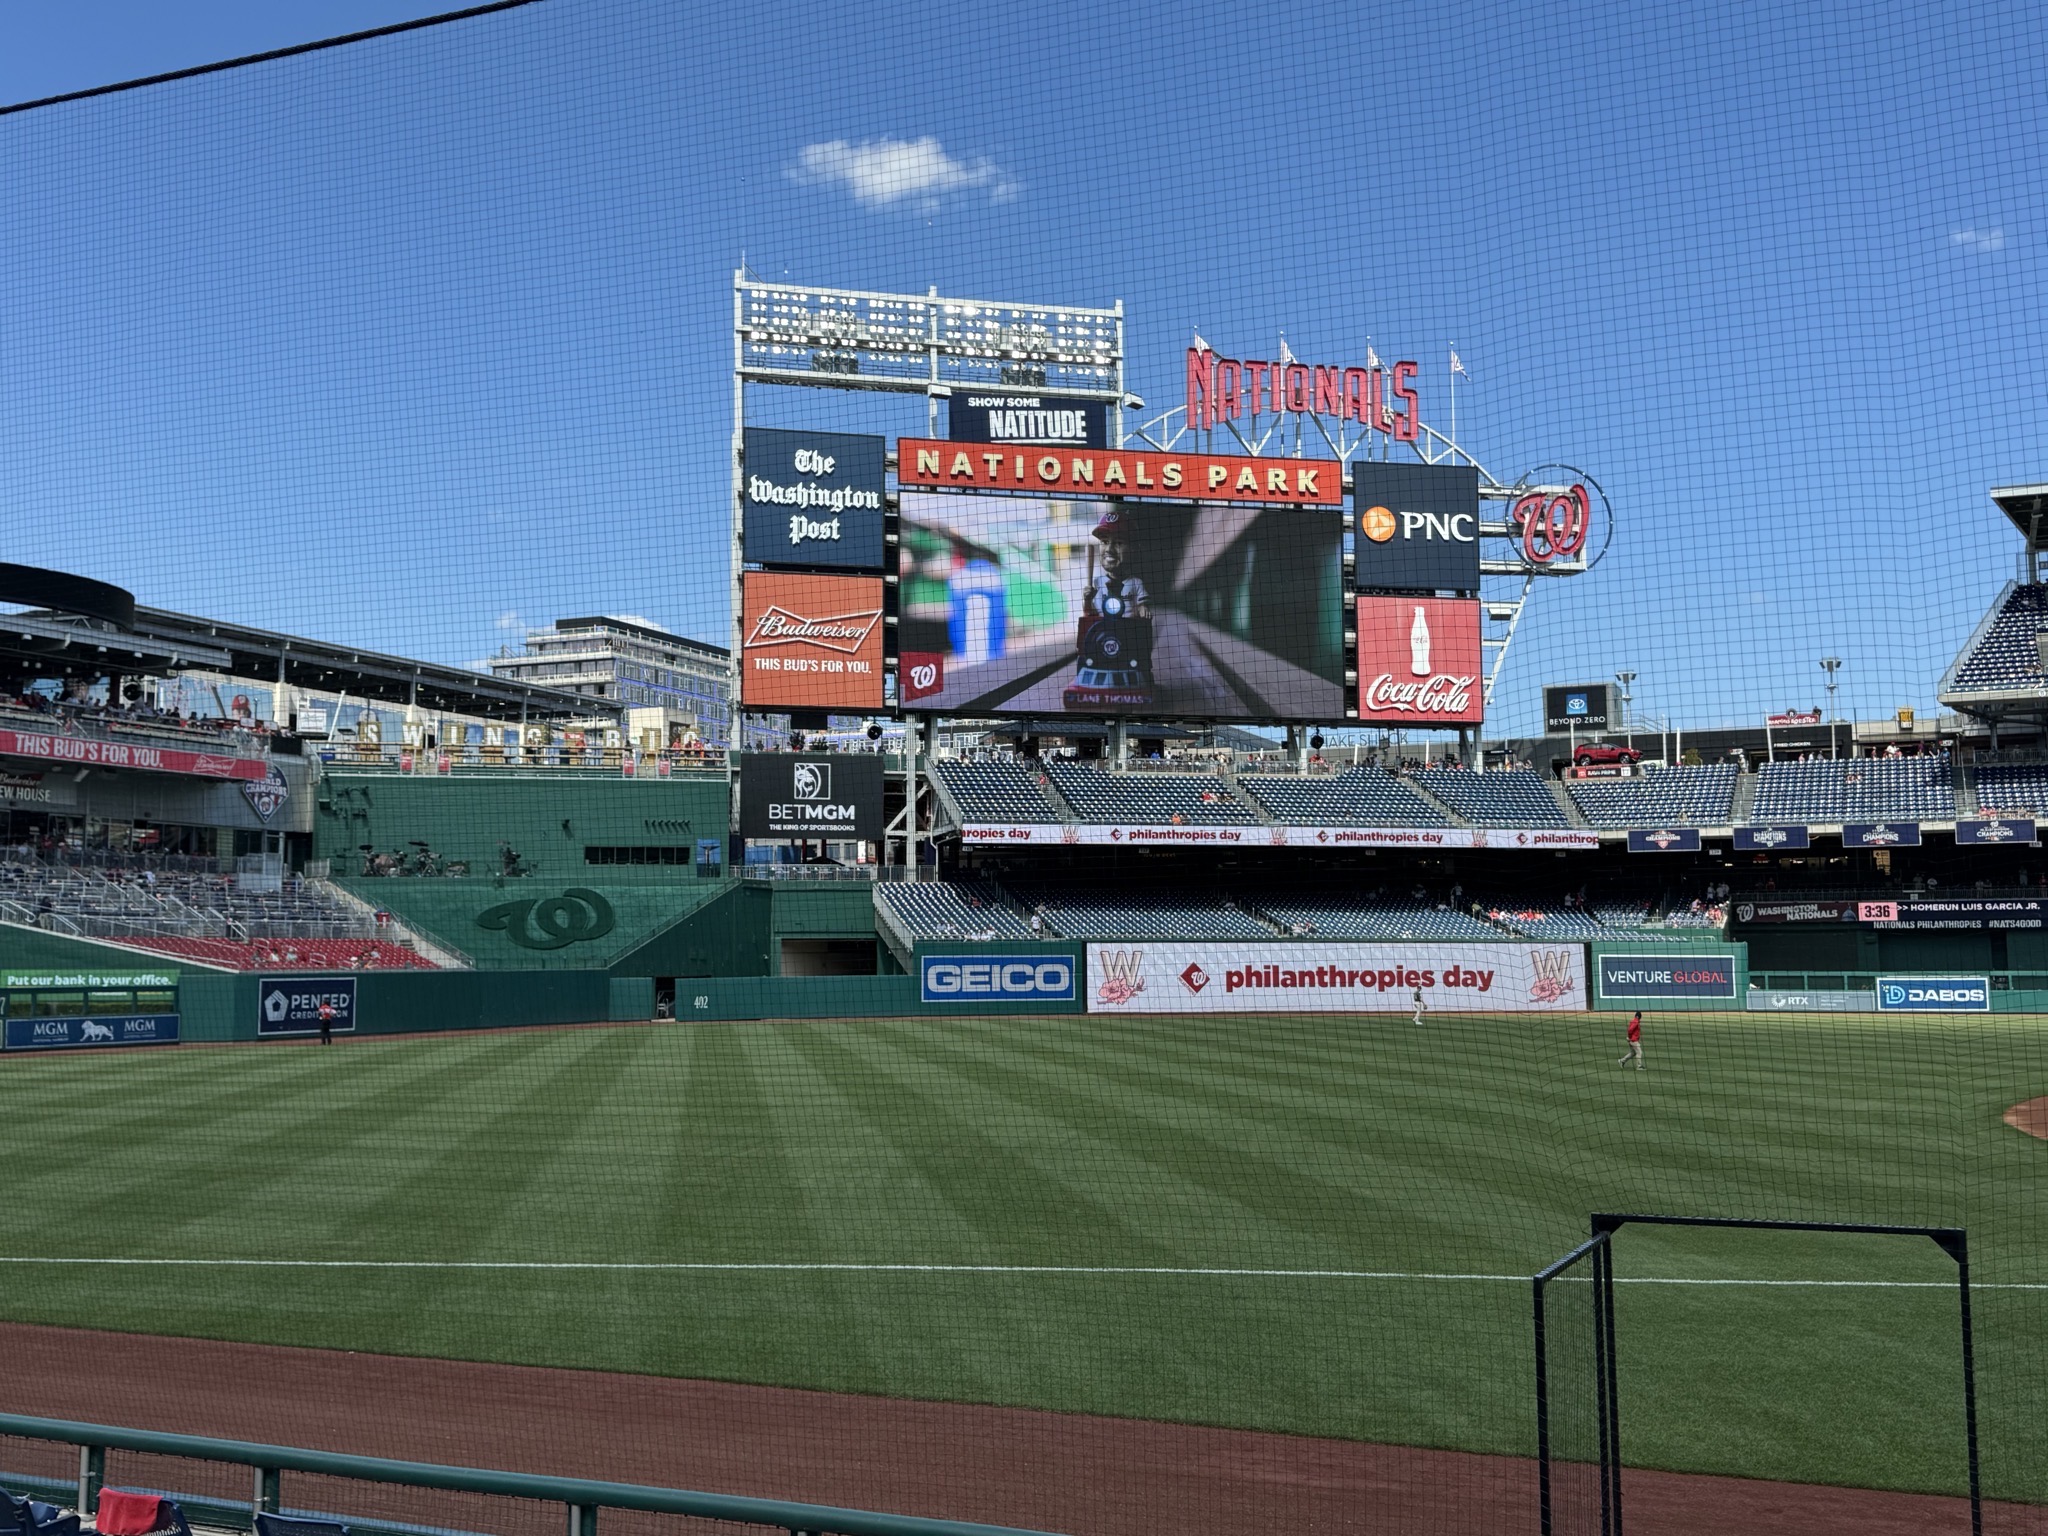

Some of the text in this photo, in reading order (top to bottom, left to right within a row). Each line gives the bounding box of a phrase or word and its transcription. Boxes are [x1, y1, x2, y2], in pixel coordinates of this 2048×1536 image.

[1187, 347, 1418, 441] NATIONALS
[968, 397, 1041, 408] SHOW SOME
[989, 410, 1087, 437] NATITUDE
[794, 449, 836, 477] The
[917, 450, 1319, 493] NATIONALS PARK
[749, 474, 881, 513] Washington
[789, 515, 841, 545] Post
[1399, 511, 1474, 542] PNC
[757, 615, 869, 638] Budweiser
[754, 658, 872, 674] THIS BUD'S FOR YOU.
[1366, 673, 1476, 713] Coca-Cola
[1549, 716, 1606, 726] BEYOND ZERO
[16, 734, 164, 768] THIS BUD'S FOR YOU.
[16, 787, 51, 803] HOUSE
[246, 782, 287, 797] CHAMPIONS
[768, 804, 856, 820] BETMGM
[1008, 828, 1032, 842] day
[1128, 828, 1242, 842] philanthropies day
[1334, 831, 1444, 844] philanthropies day
[1533, 832, 1599, 846] philanthrop
[1976, 830, 2014, 838] CHAMPIONS
[1757, 904, 1818, 916] WASHINGTON
[1864, 905, 1891, 918] 3:36
[1910, 902, 2040, 912] HOMERUN LUIS GARCIA JR.
[1786, 909, 1838, 921] NATIONALS
[1874, 920, 2042, 929] NATIONALS PHILANTHROPIES #NATS4GOOD
[8, 974, 172, 987] Put our bank in your office.
[927, 964, 1070, 993] GEICO
[1226, 964, 1435, 993] philanthropies
[1443, 965, 1495, 992] day
[1608, 970, 1728, 984] VENTURE GLOBAL
[291, 994, 350, 1008] PENFED
[694, 996, 708, 1009] 402
[1788, 996, 1809, 1005] RTX
[1908, 990, 1984, 1002] DABOS
[290, 1010, 319, 1020] CREDIT
[34, 1022, 69, 1036] MGM
[124, 1019, 156, 1032] MGM
